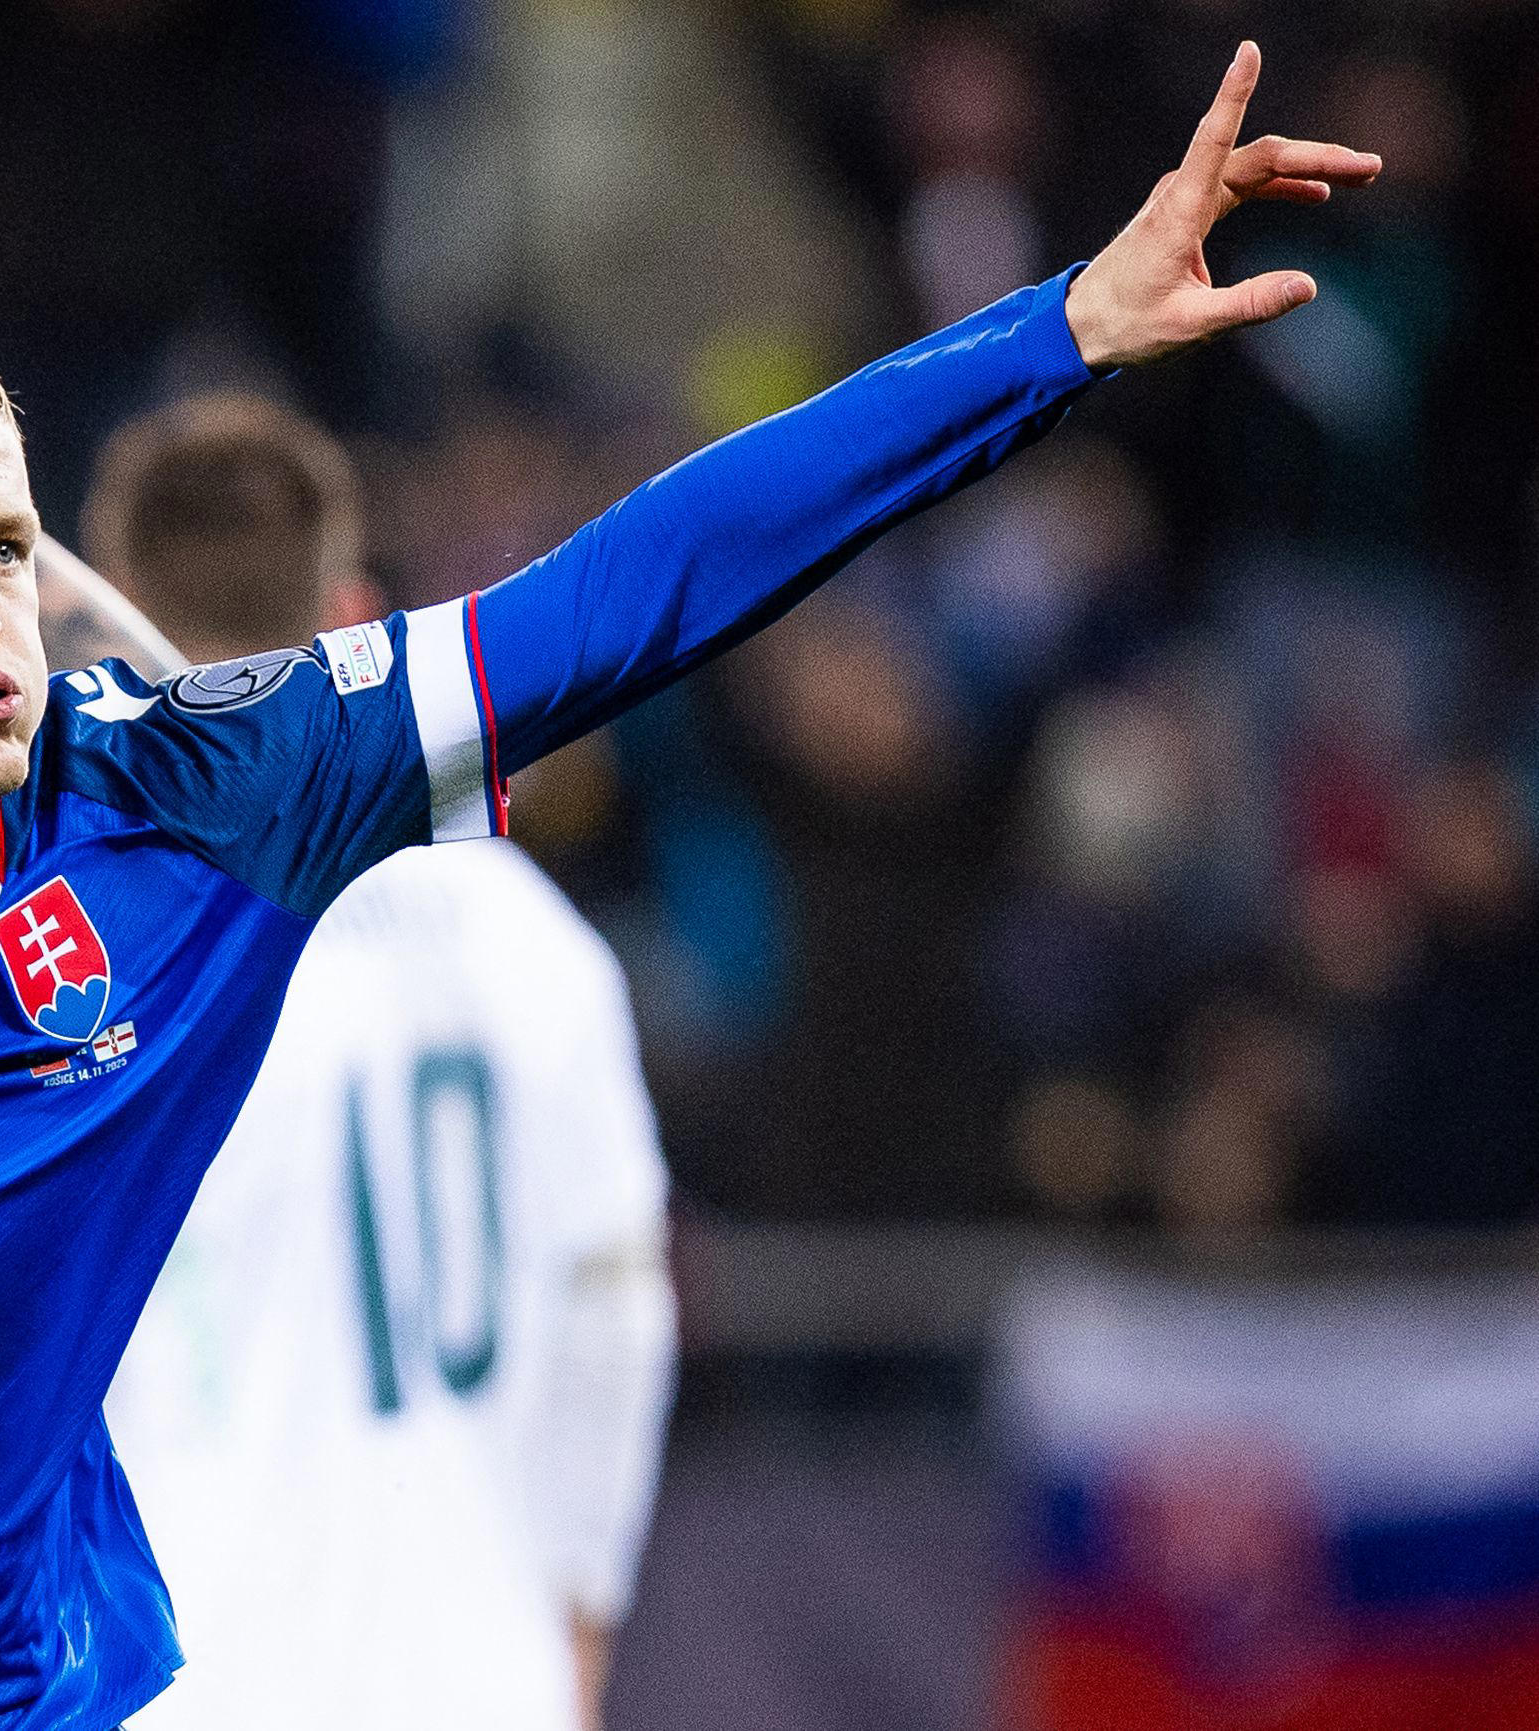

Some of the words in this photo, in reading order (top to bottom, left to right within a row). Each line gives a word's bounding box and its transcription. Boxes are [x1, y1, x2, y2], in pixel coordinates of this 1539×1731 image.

[337, 662, 352, 688] UEFA
[43, 1072, 76, 1087] KOŠICE
[344, 1046, 500, 1416] 10
